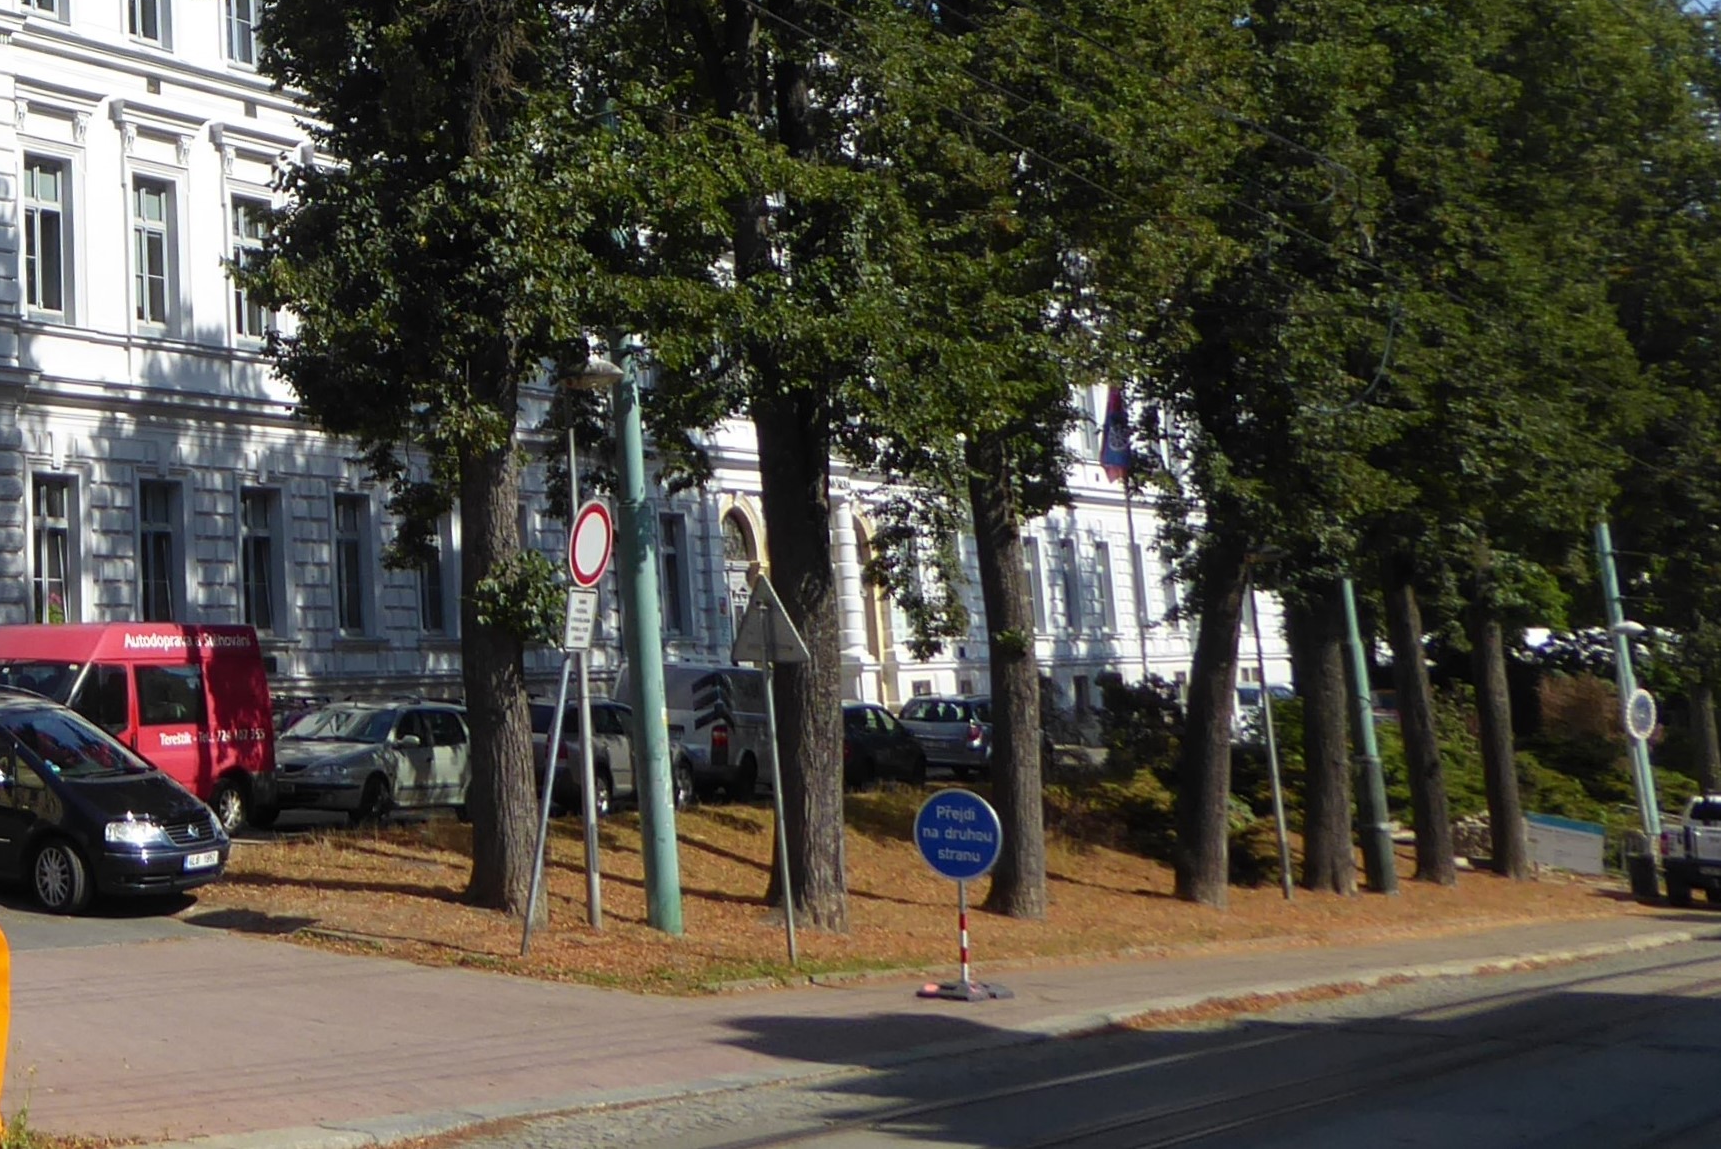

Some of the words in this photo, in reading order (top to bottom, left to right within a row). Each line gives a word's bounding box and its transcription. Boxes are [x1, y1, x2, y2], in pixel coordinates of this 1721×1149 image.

[124, 632, 193, 651] Autodoprava
[936, 805, 976, 823] Přejdi
[922, 827, 939, 838] na
[944, 826, 993, 842] druhou
[937, 847, 981, 862] stranu
